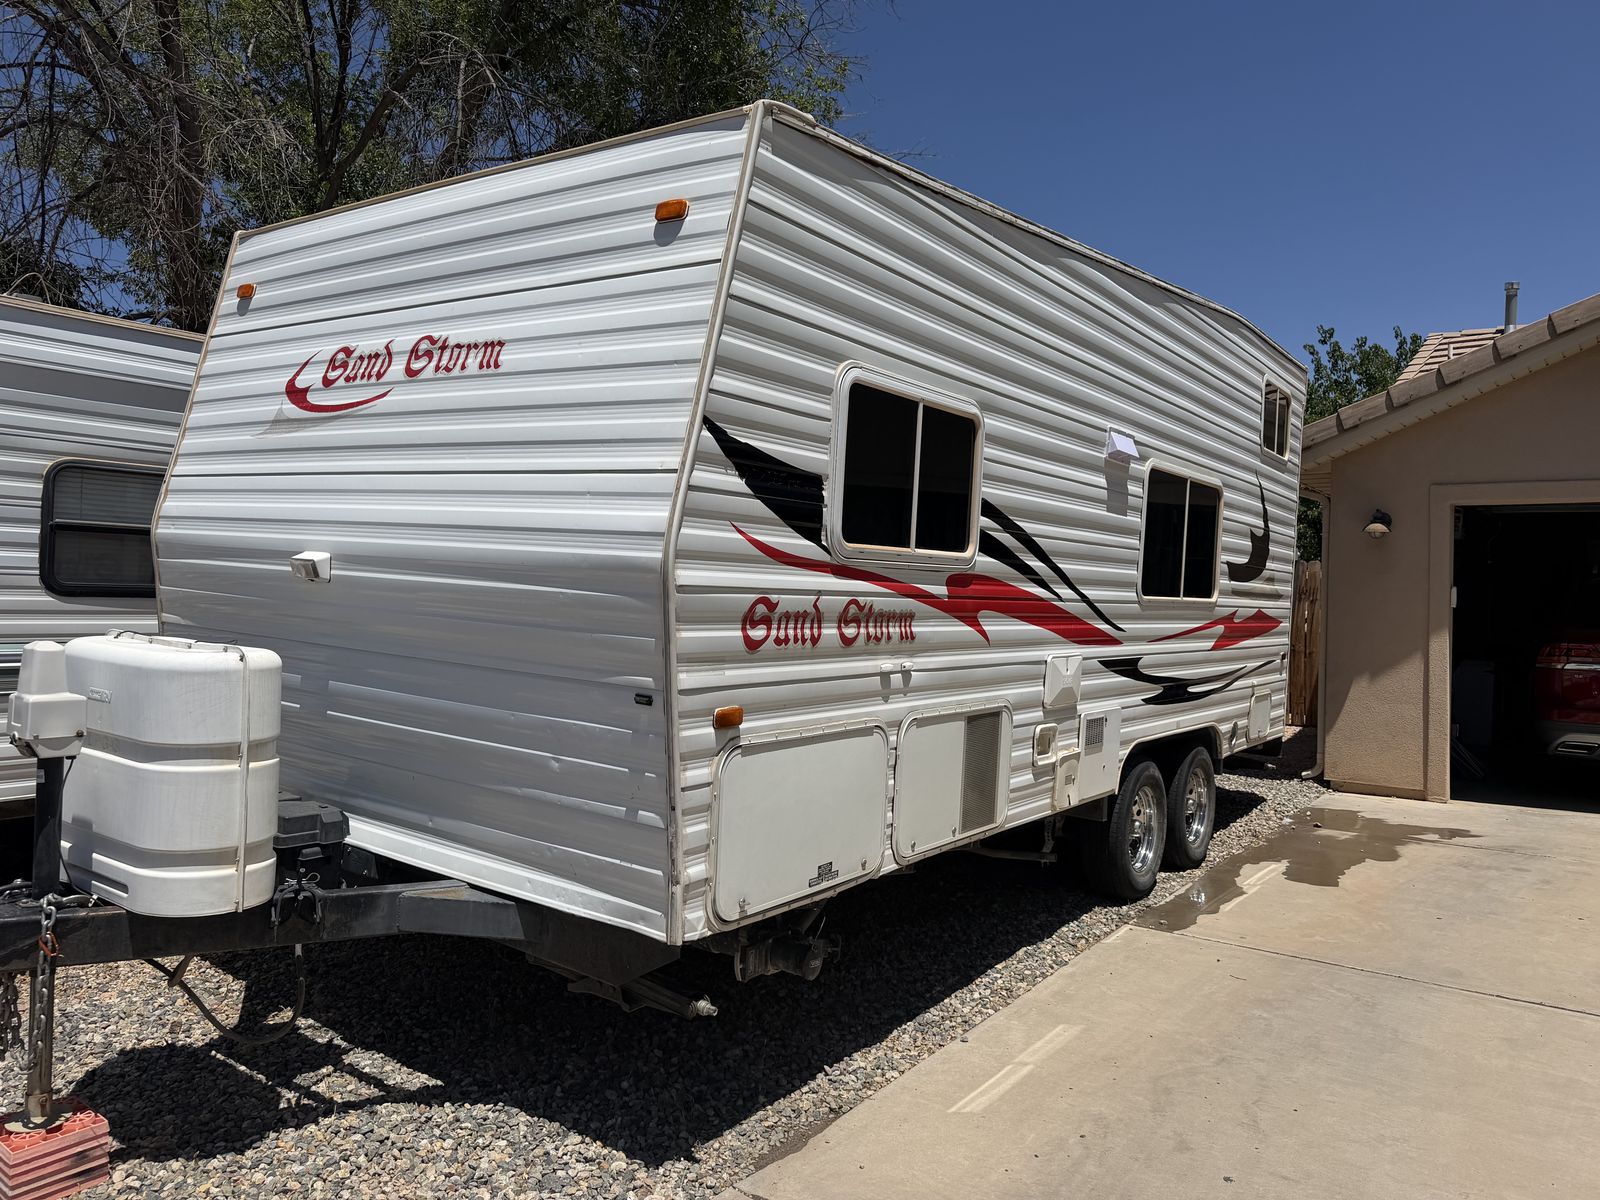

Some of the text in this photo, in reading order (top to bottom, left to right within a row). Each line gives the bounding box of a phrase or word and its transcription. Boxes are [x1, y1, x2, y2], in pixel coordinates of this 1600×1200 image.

[321, 334, 506, 388] Sand Storm
[741, 591, 917, 652] Sand Storm
